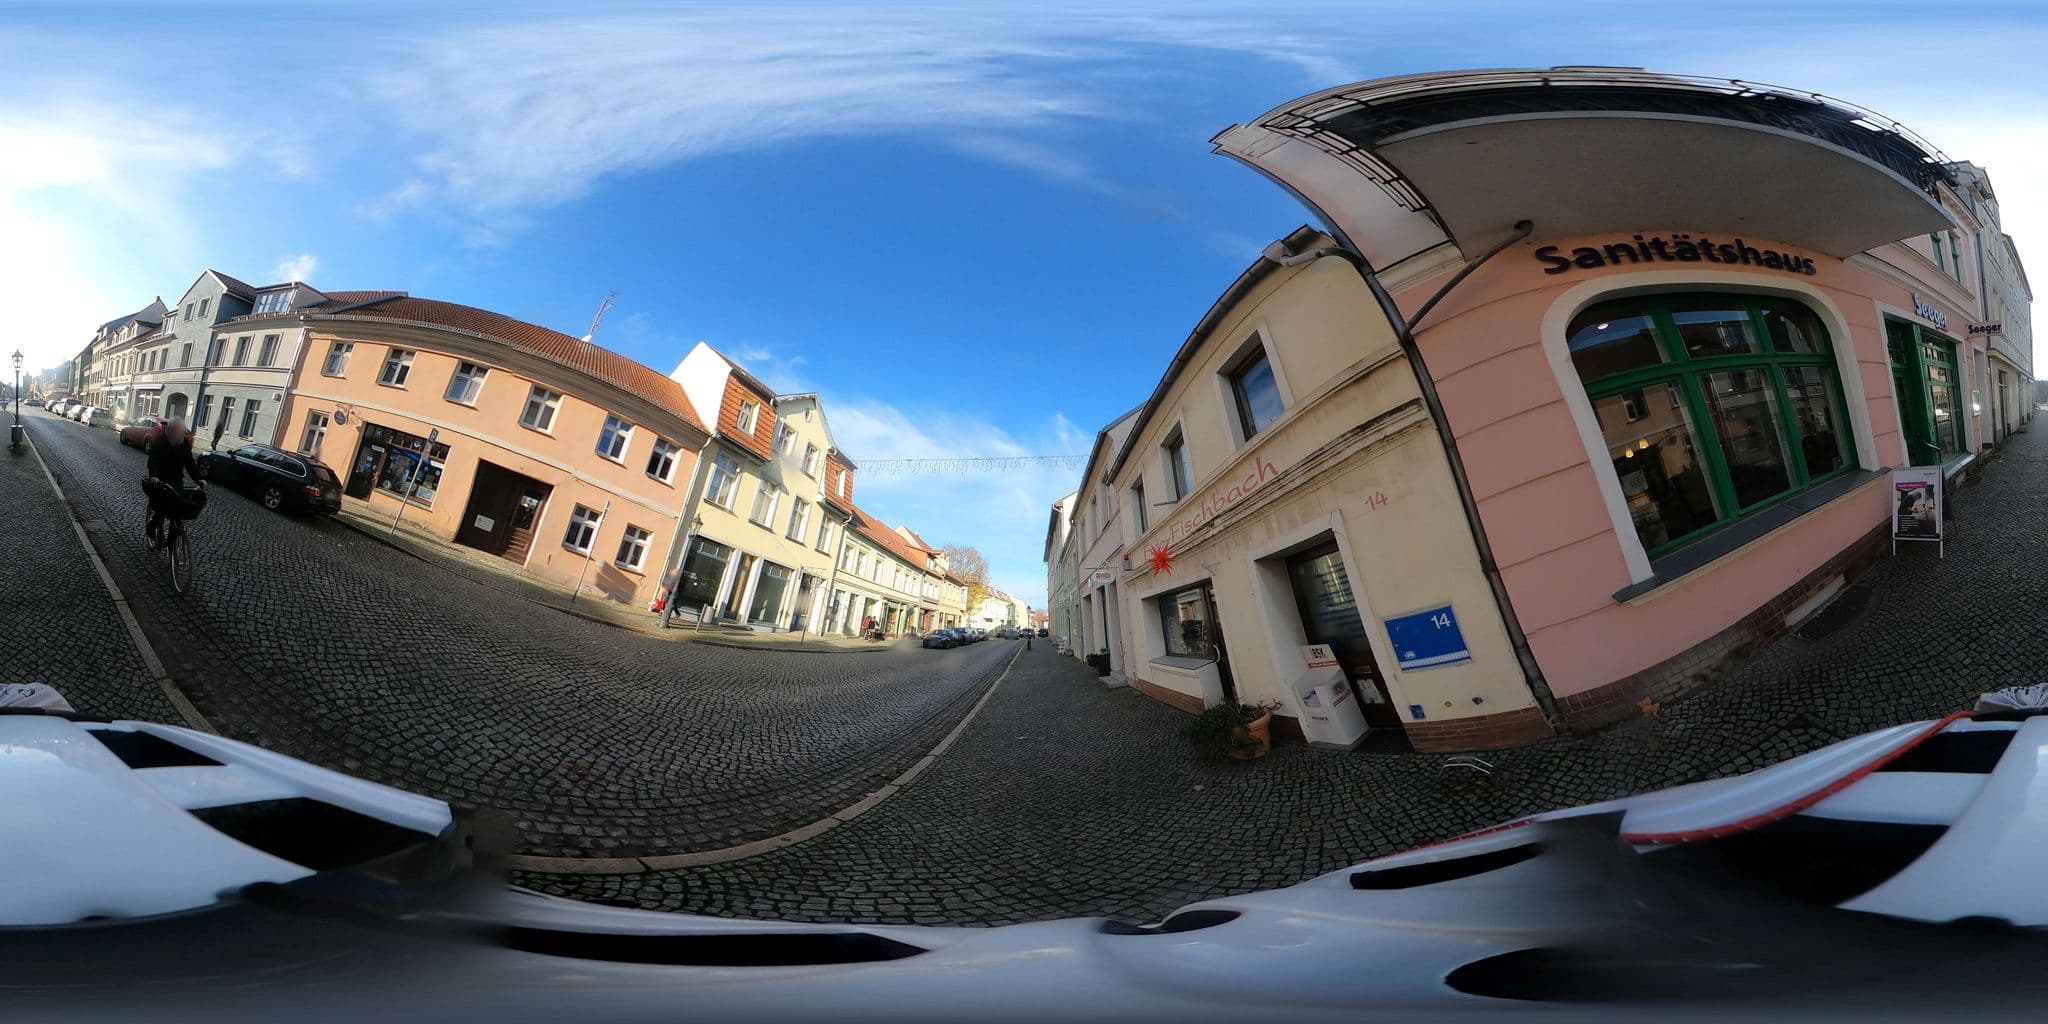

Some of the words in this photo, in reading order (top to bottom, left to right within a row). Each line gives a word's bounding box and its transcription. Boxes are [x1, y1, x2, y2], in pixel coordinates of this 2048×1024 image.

[1535, 233, 1817, 276] Sanitätshaus
[1912, 292, 1948, 330] Seeger
[1967, 323, 2002, 335] Seeger
[1364, 490, 1388, 511] 14
[1430, 612, 1452, 630] 14
